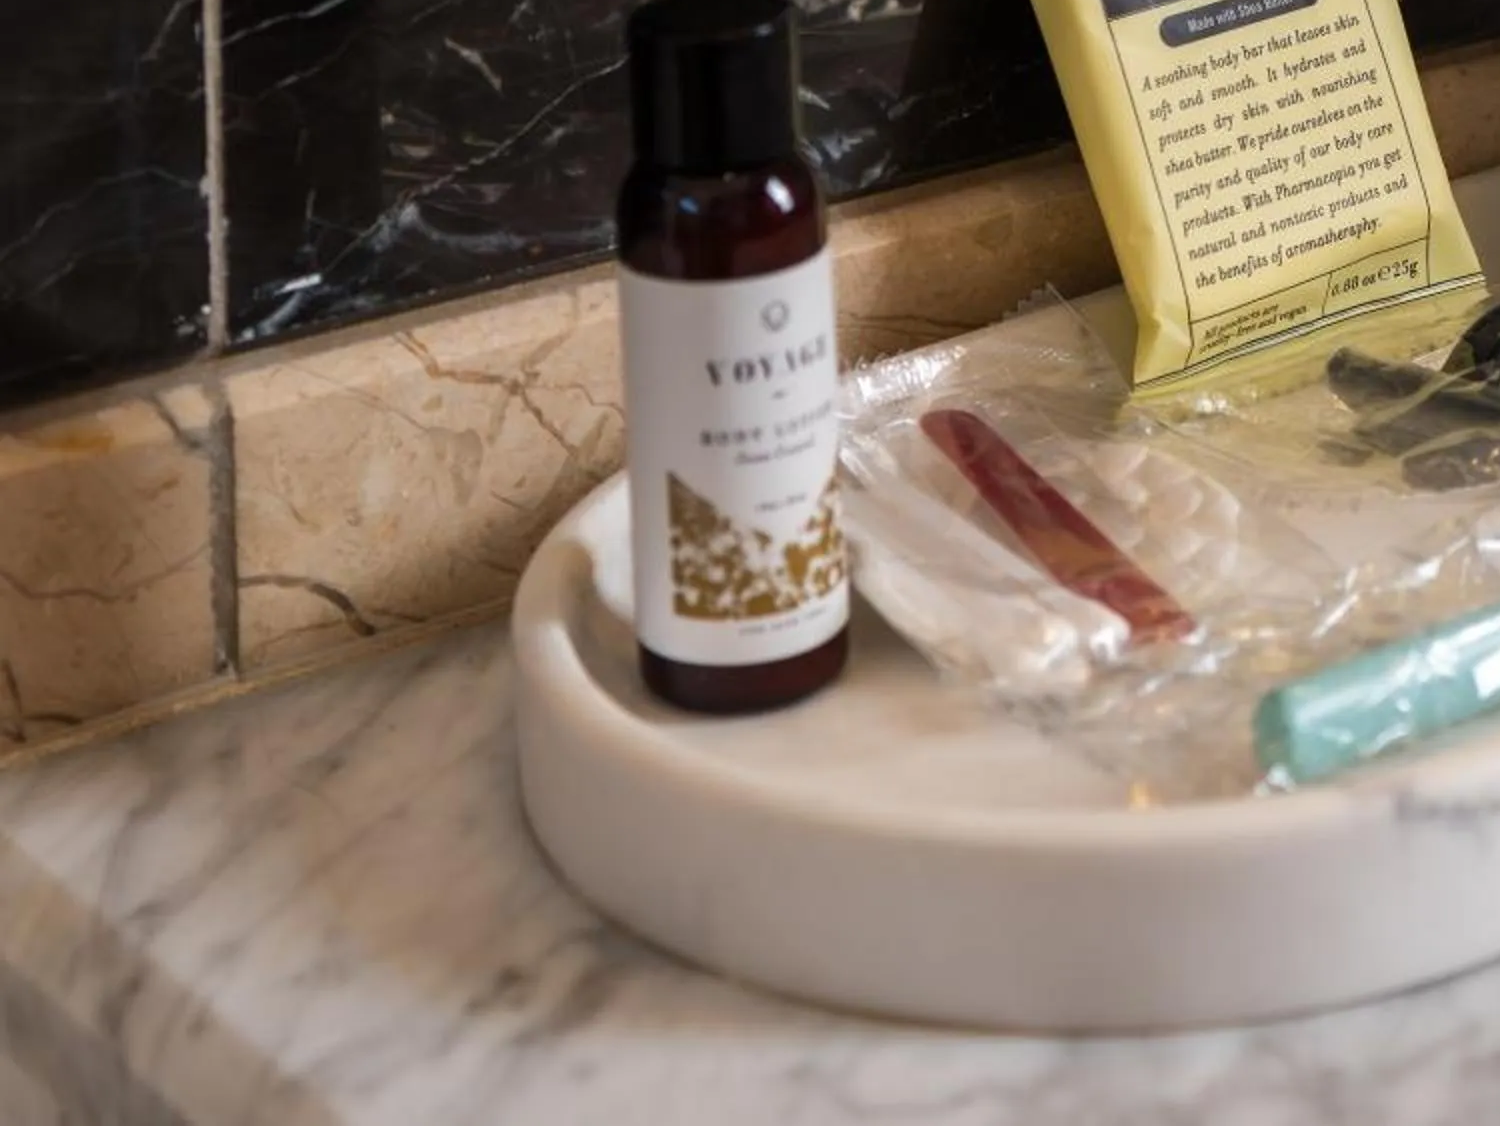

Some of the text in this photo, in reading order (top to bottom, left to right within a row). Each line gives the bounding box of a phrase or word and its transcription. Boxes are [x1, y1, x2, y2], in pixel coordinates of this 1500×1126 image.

[1142, 14, 1360, 92] A soothing body bar that leaves skin
[1187, 16, 1215, 33] Made
[1215, 9, 1236, 24] with
[1237, 2, 1262, 19] Shea
[1149, 38, 1367, 121] soft and smooth. It hydrates and
[1158, 67, 1378, 153] protects dry skin with nourishing
[1165, 93, 1383, 176] shea butter. We pride ourselves on the
[1173, 122, 1393, 209] purity and quality of our body care
[1182, 148, 1404, 236] products. With Pharmacopia you get
[1188, 174, 1409, 260] natural and nontoxic products and
[1195, 273, 1217, 289] the
[1217, 254, 1269, 282] benefits
[1272, 246, 1285, 267] of
[1391, 259, 1420, 278] 25g
